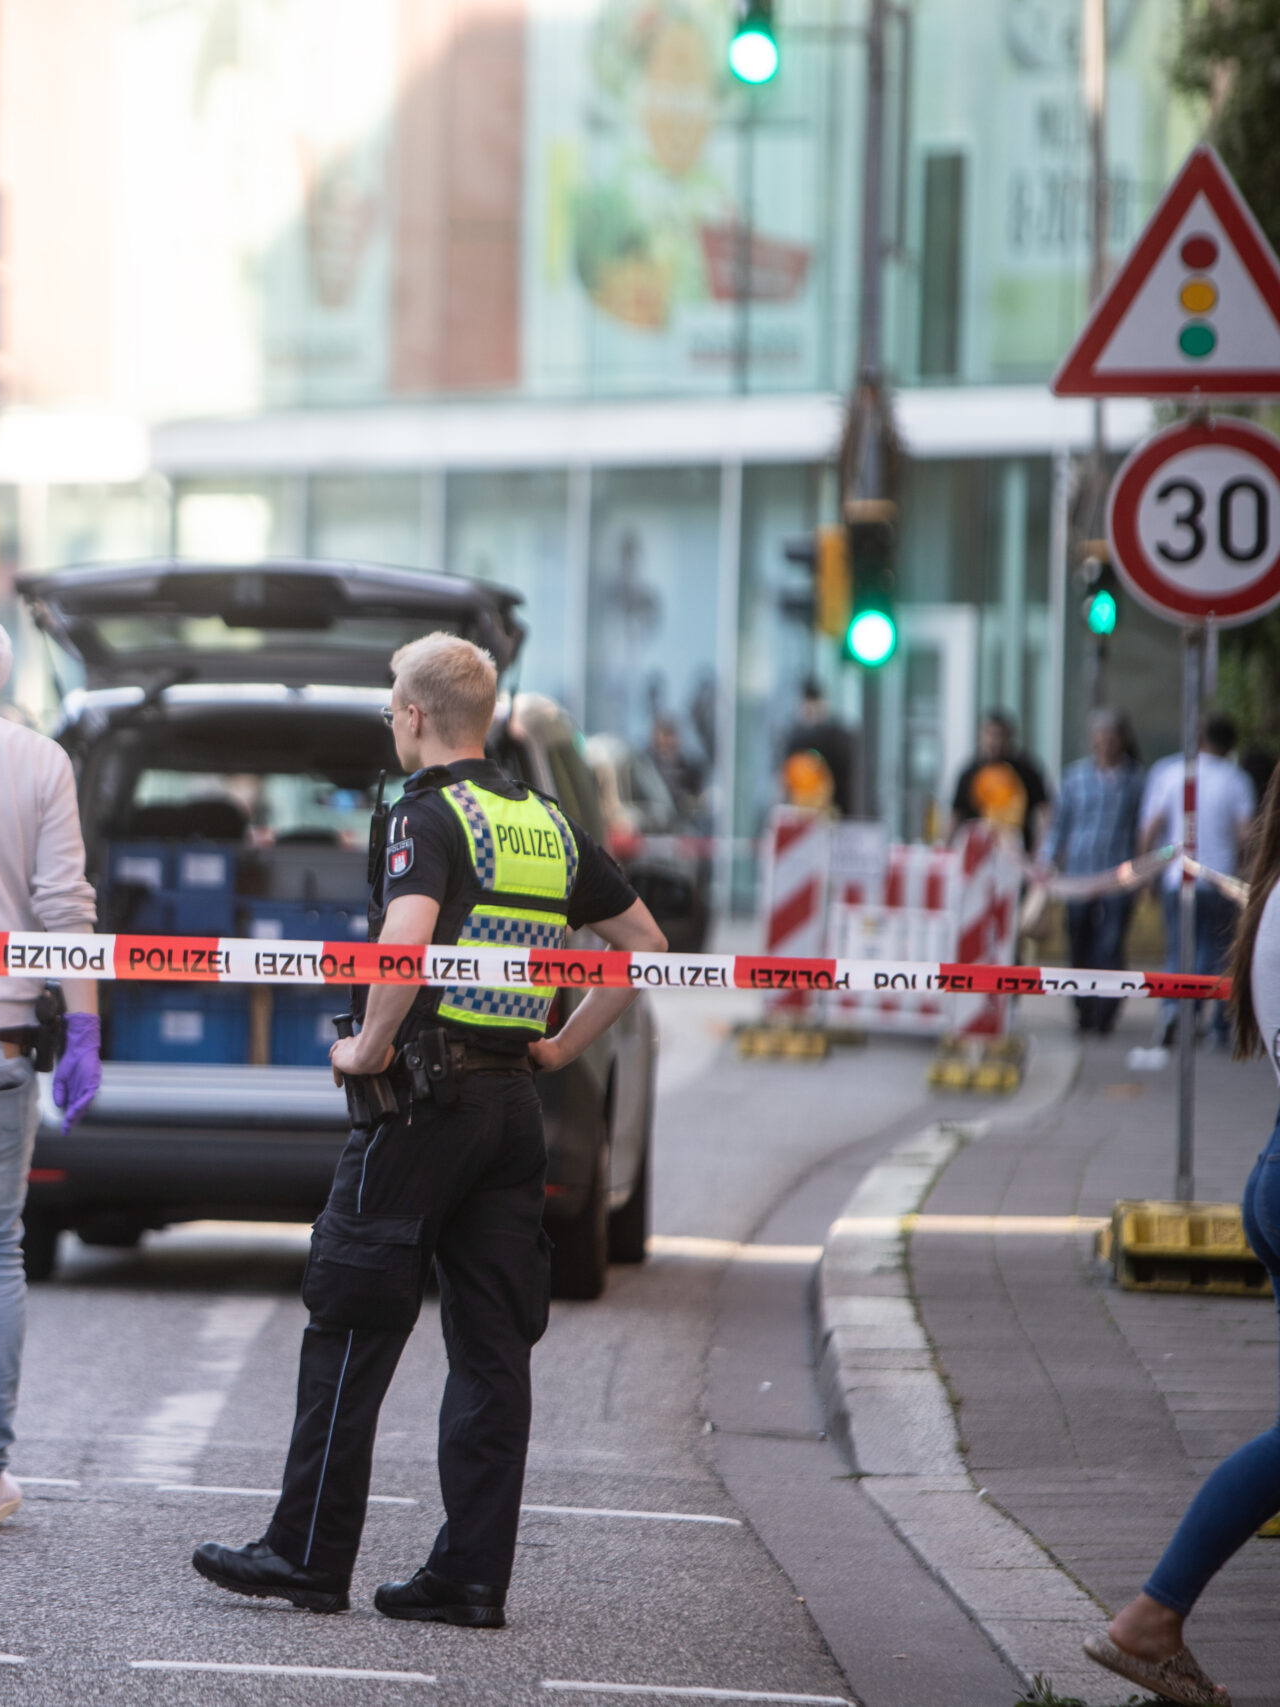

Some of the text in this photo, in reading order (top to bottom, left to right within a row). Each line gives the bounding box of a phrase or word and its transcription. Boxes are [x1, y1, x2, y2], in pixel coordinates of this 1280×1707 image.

[1156, 476, 1270, 566] 30
[496, 824, 562, 860] POLIZEI
[3, 944, 105, 971] POLIZEI
[129, 947, 231, 974] POLIZEI
[255, 952, 356, 978] POLIZEI
[379, 955, 480, 981] POLIZEI
[503, 960, 604, 985] POLIZEI
[627, 964, 728, 987] POLIZEI
